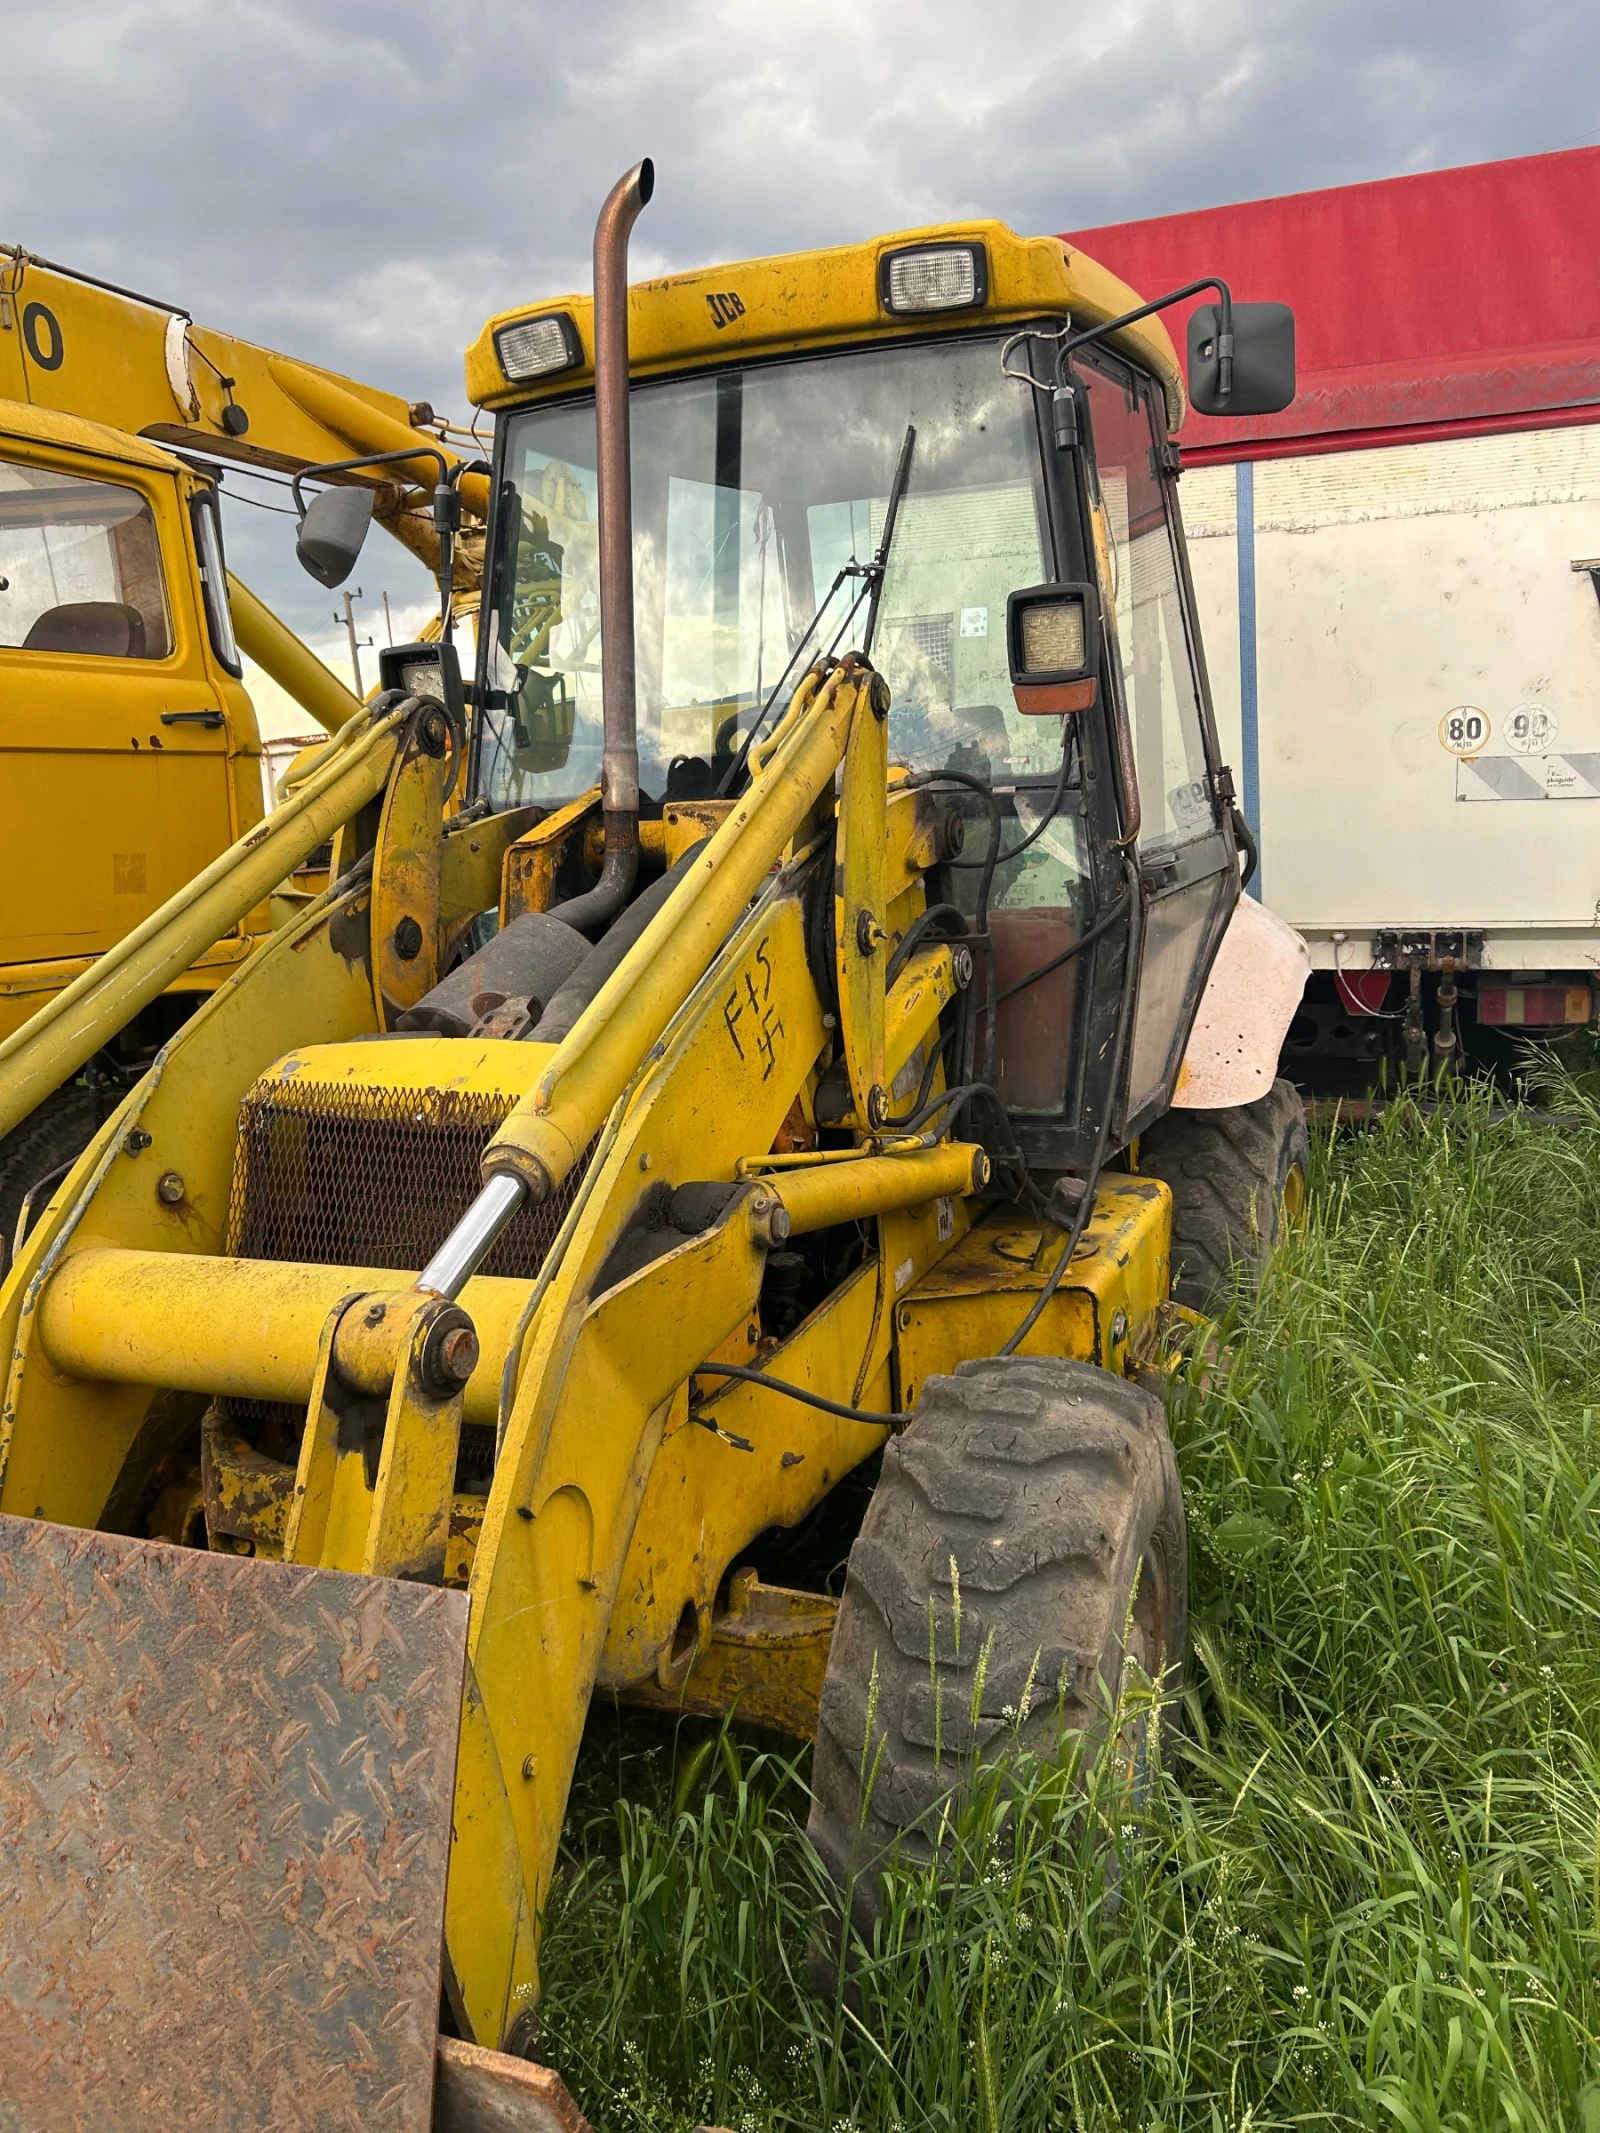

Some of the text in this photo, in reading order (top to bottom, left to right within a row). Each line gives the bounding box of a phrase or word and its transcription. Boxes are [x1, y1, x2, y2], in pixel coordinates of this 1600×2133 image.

[706, 292, 746, 329] JCB
[1449, 716, 1482, 741] 80
[1513, 714, 1549, 739] 90
